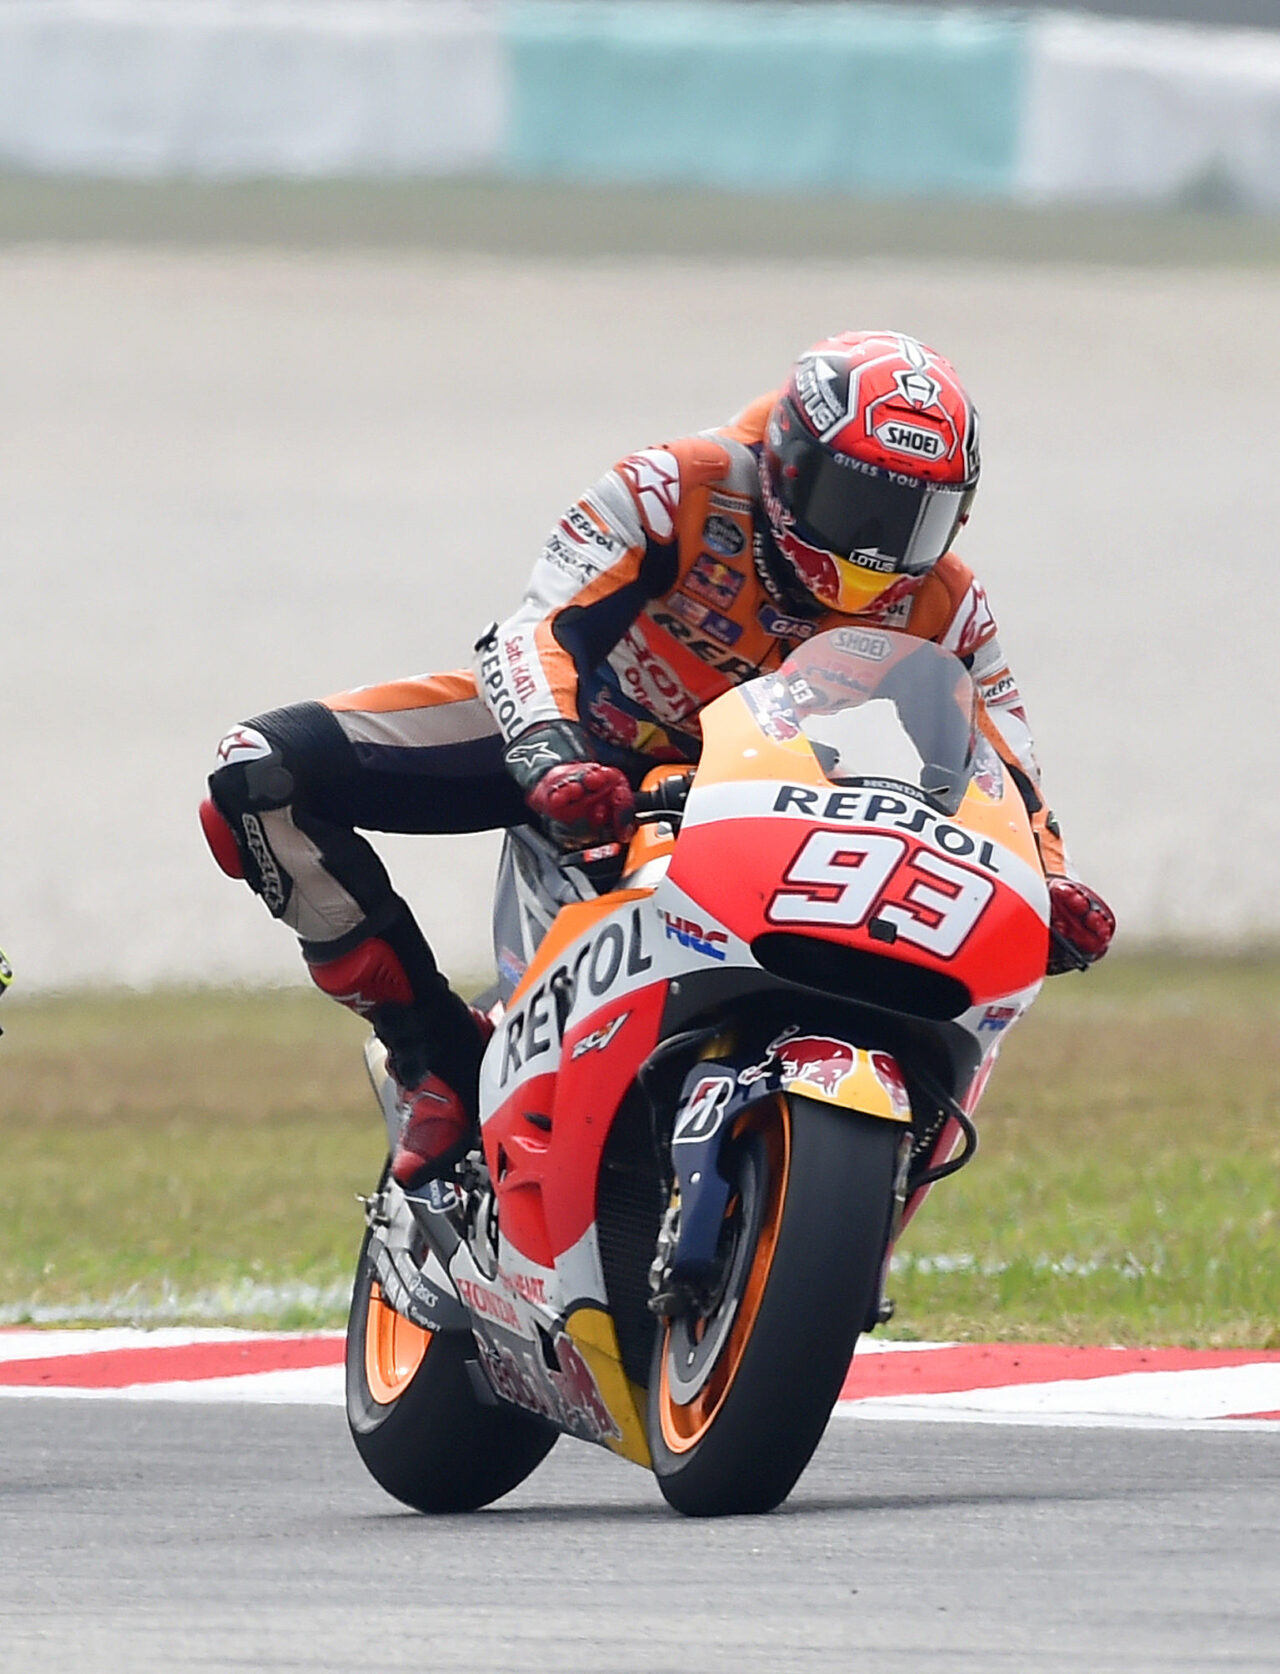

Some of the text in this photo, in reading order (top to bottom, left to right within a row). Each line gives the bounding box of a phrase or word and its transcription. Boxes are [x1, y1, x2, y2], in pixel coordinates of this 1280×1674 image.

[886, 426, 939, 455] SHOEI
[833, 452, 879, 477] GIVES
[887, 470, 919, 488] YOU
[570, 507, 614, 552] EPSOL
[848, 551, 896, 573] LOTUS
[836, 631, 885, 660] SHOEI
[863, 779, 926, 802] HONDA
[773, 785, 999, 873] REPSOL
[765, 828, 996, 961] 93
